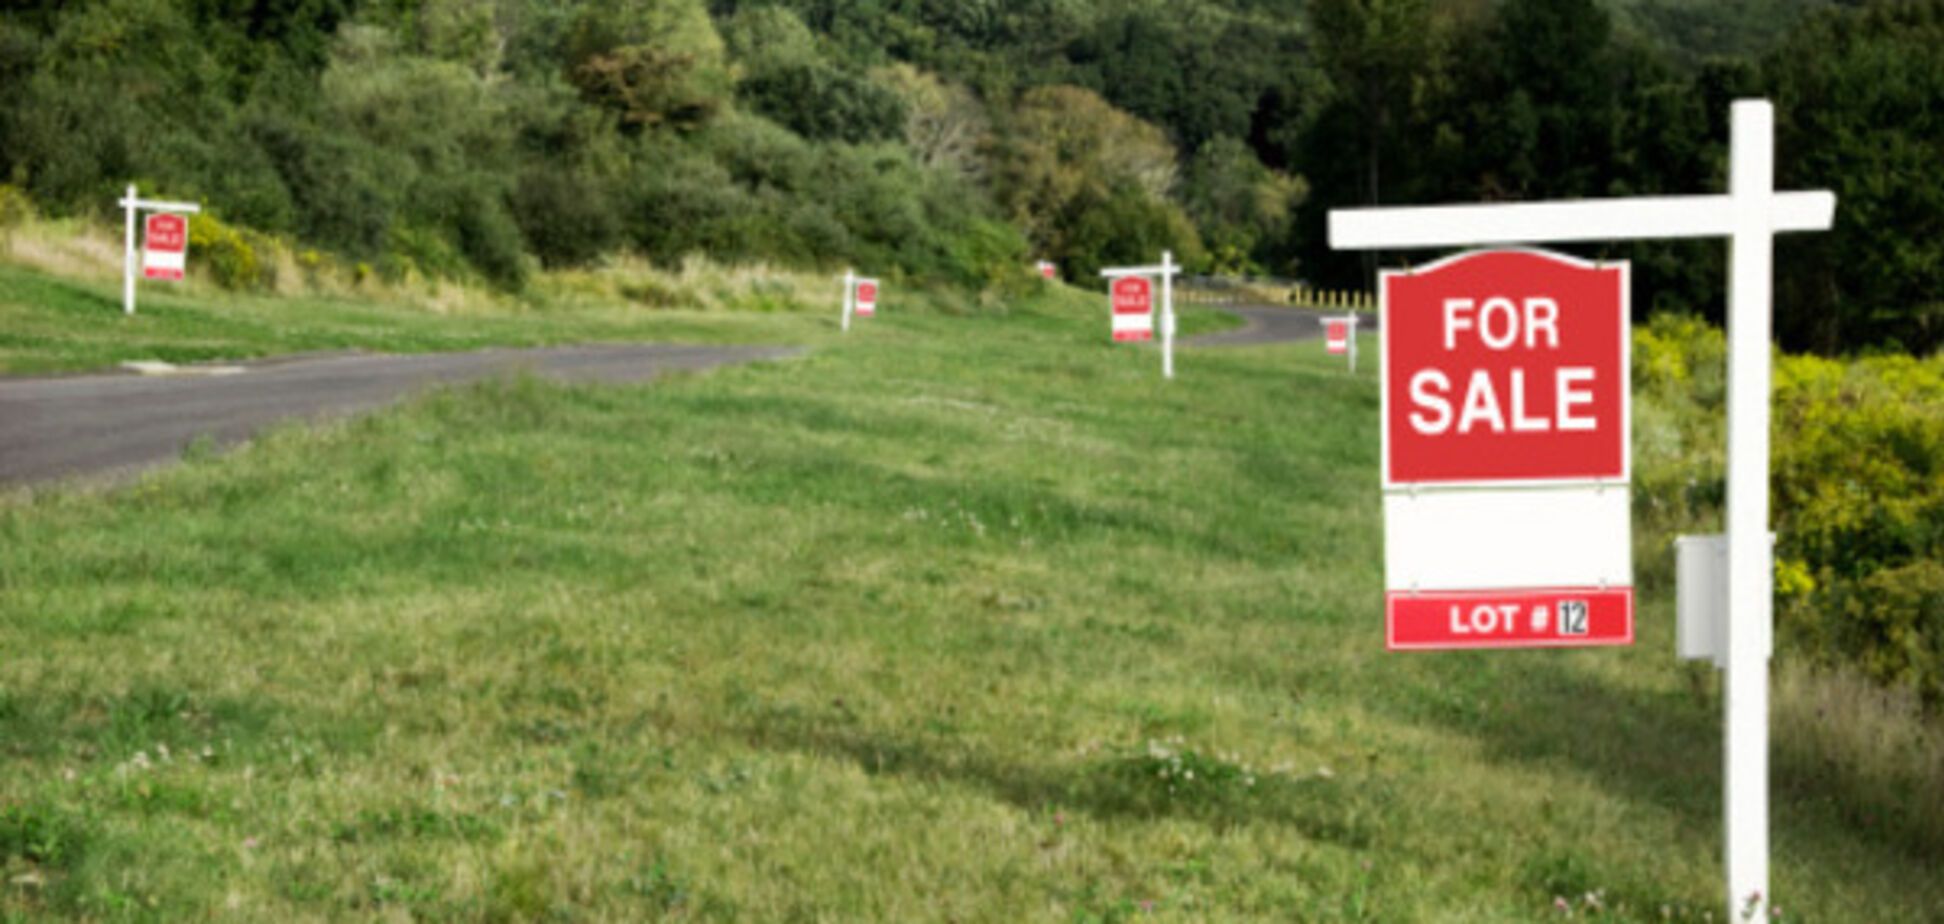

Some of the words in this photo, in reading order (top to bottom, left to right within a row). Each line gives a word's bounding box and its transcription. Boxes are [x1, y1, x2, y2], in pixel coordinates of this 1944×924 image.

[1444, 296, 1558, 350] FOR
[1409, 367, 1597, 435] SALE
[1450, 604, 1520, 633] LOT
[1531, 605, 1549, 632] #
[1560, 601, 1587, 633] 12
